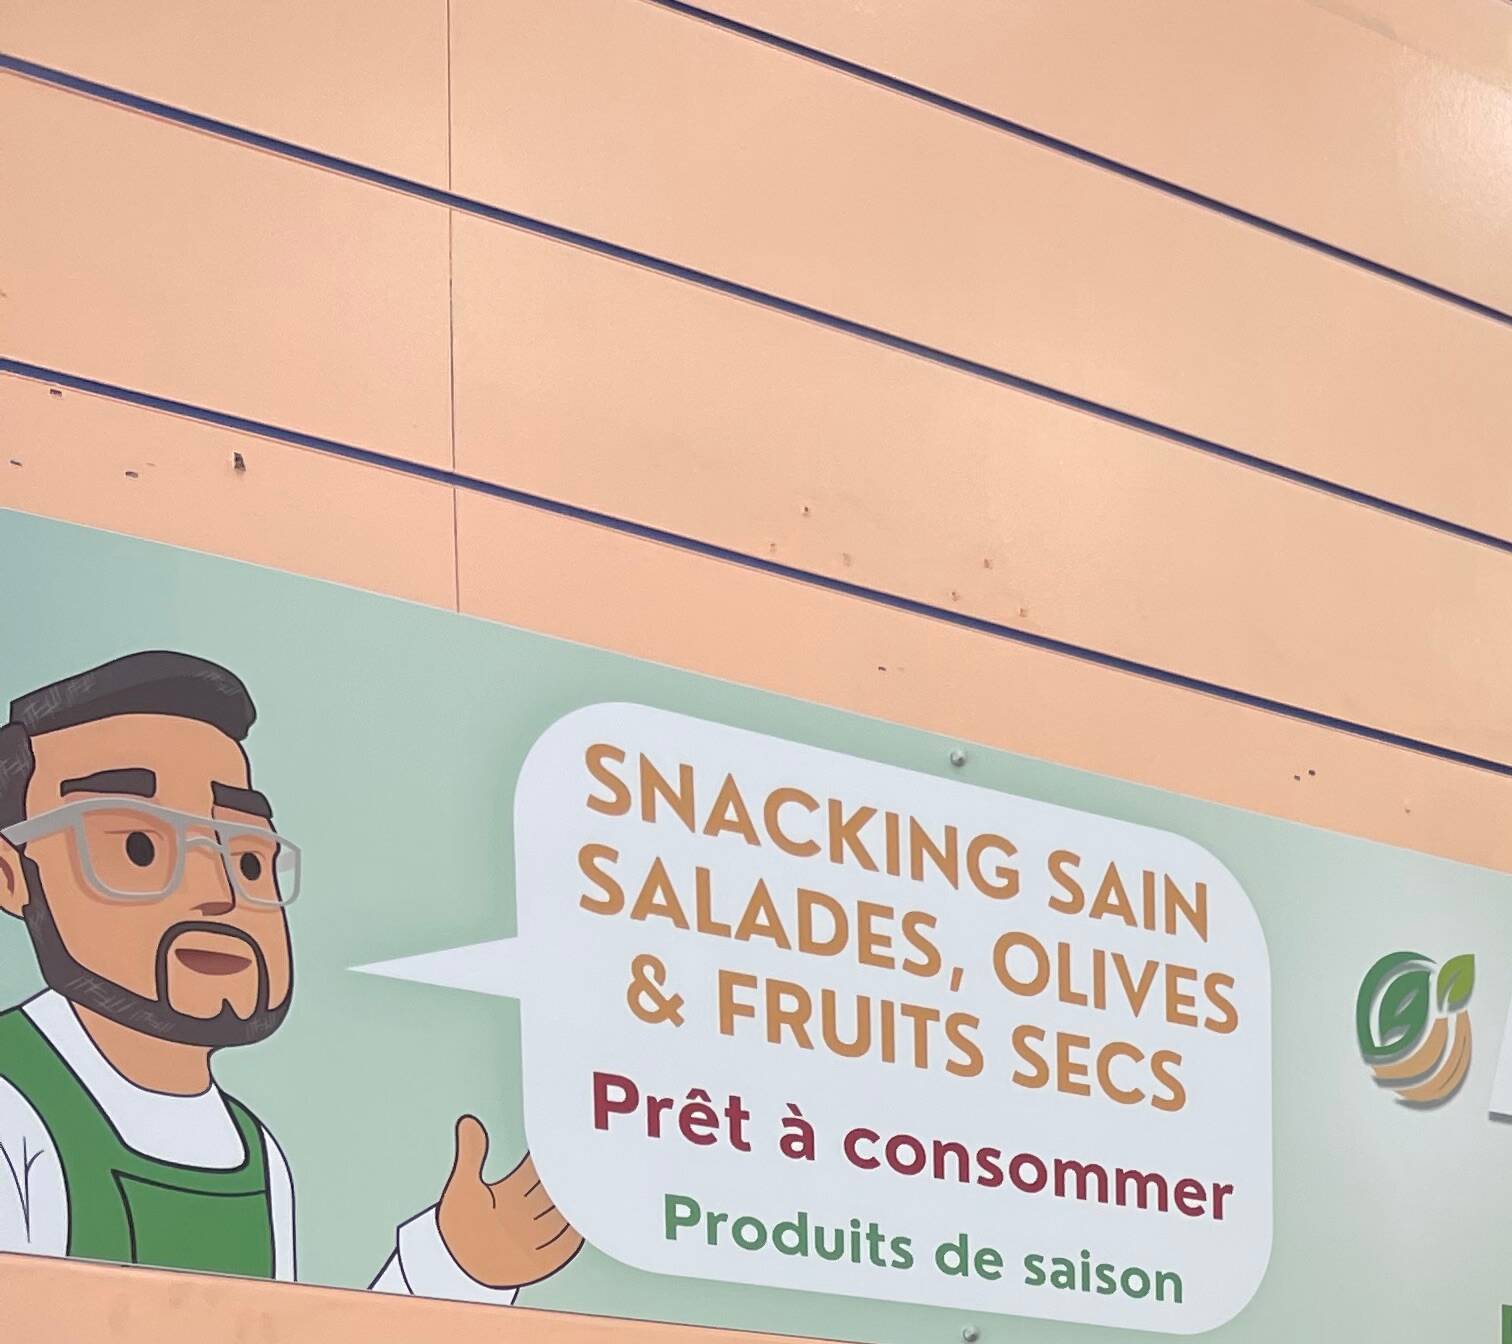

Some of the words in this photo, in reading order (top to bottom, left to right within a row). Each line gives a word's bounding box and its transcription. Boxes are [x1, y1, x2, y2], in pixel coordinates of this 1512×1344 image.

[585, 743, 1020, 900] SNACKING
[1047, 850, 1208, 942] SAIN
[578, 843, 964, 992] SALADES,
[992, 931, 1240, 1035] OLIVES
[626, 953, 686, 1029] &
[717, 968, 985, 1079] FRUITS
[1011, 1025, 1187, 1112] SECS
[592, 1071, 752, 1153] Prêt
[779, 1103, 814, 1162] à
[843, 1127, 1234, 1221] consommer
[664, 1193, 914, 1270] Produits
[935, 1233, 1003, 1282] de
[1023, 1249, 1184, 1304] saison
